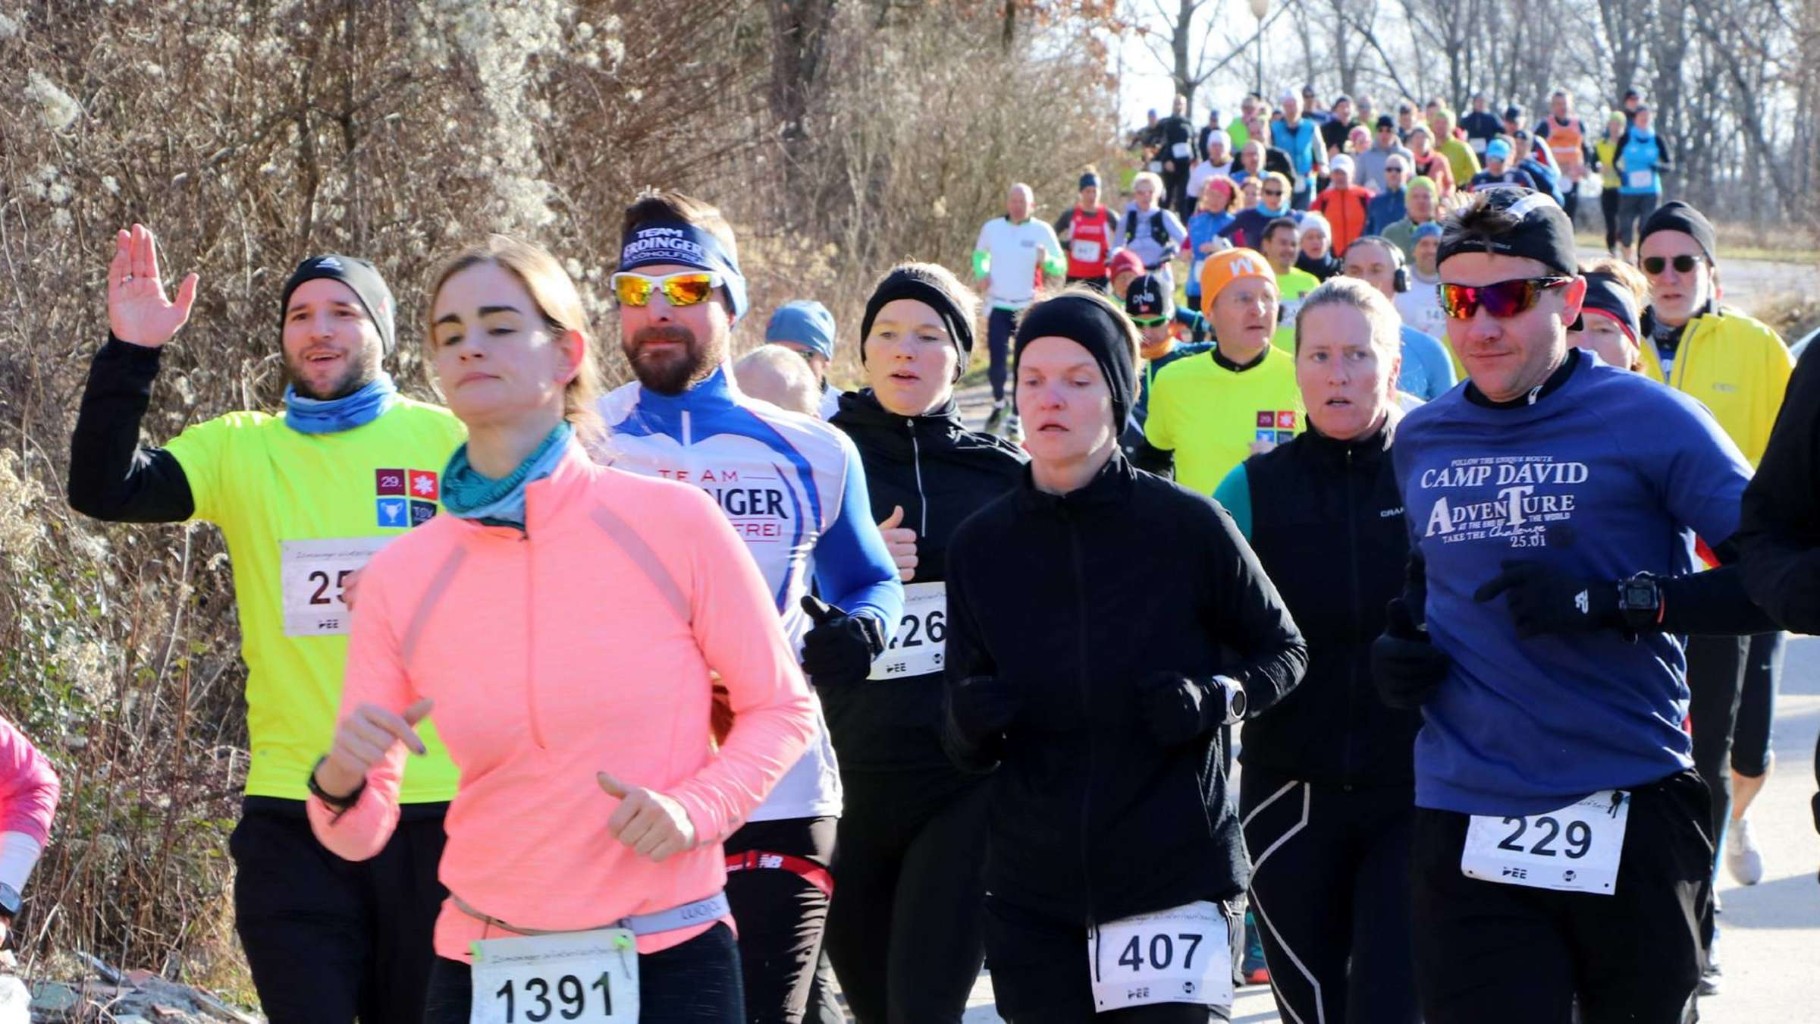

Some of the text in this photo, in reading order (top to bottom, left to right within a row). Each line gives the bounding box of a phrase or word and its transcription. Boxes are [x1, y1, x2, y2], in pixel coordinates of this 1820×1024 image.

[636, 228, 683, 238] TEAM
[623, 237, 705, 259] ERDINGER
[658, 469, 738, 482] TEAM
[1421, 462, 1588, 488] CAMP DAVID
[1451, 458, 1478, 467] FOLLOW
[1425, 485, 1575, 537] ADVENTURE
[1442, 532, 1465, 544] TAKE
[1466, 530, 1485, 540] THE
[889, 611, 946, 649] 26
[1497, 816, 1592, 859] 229
[1118, 934, 1203, 971] 407
[496, 971, 613, 1024] 1391
